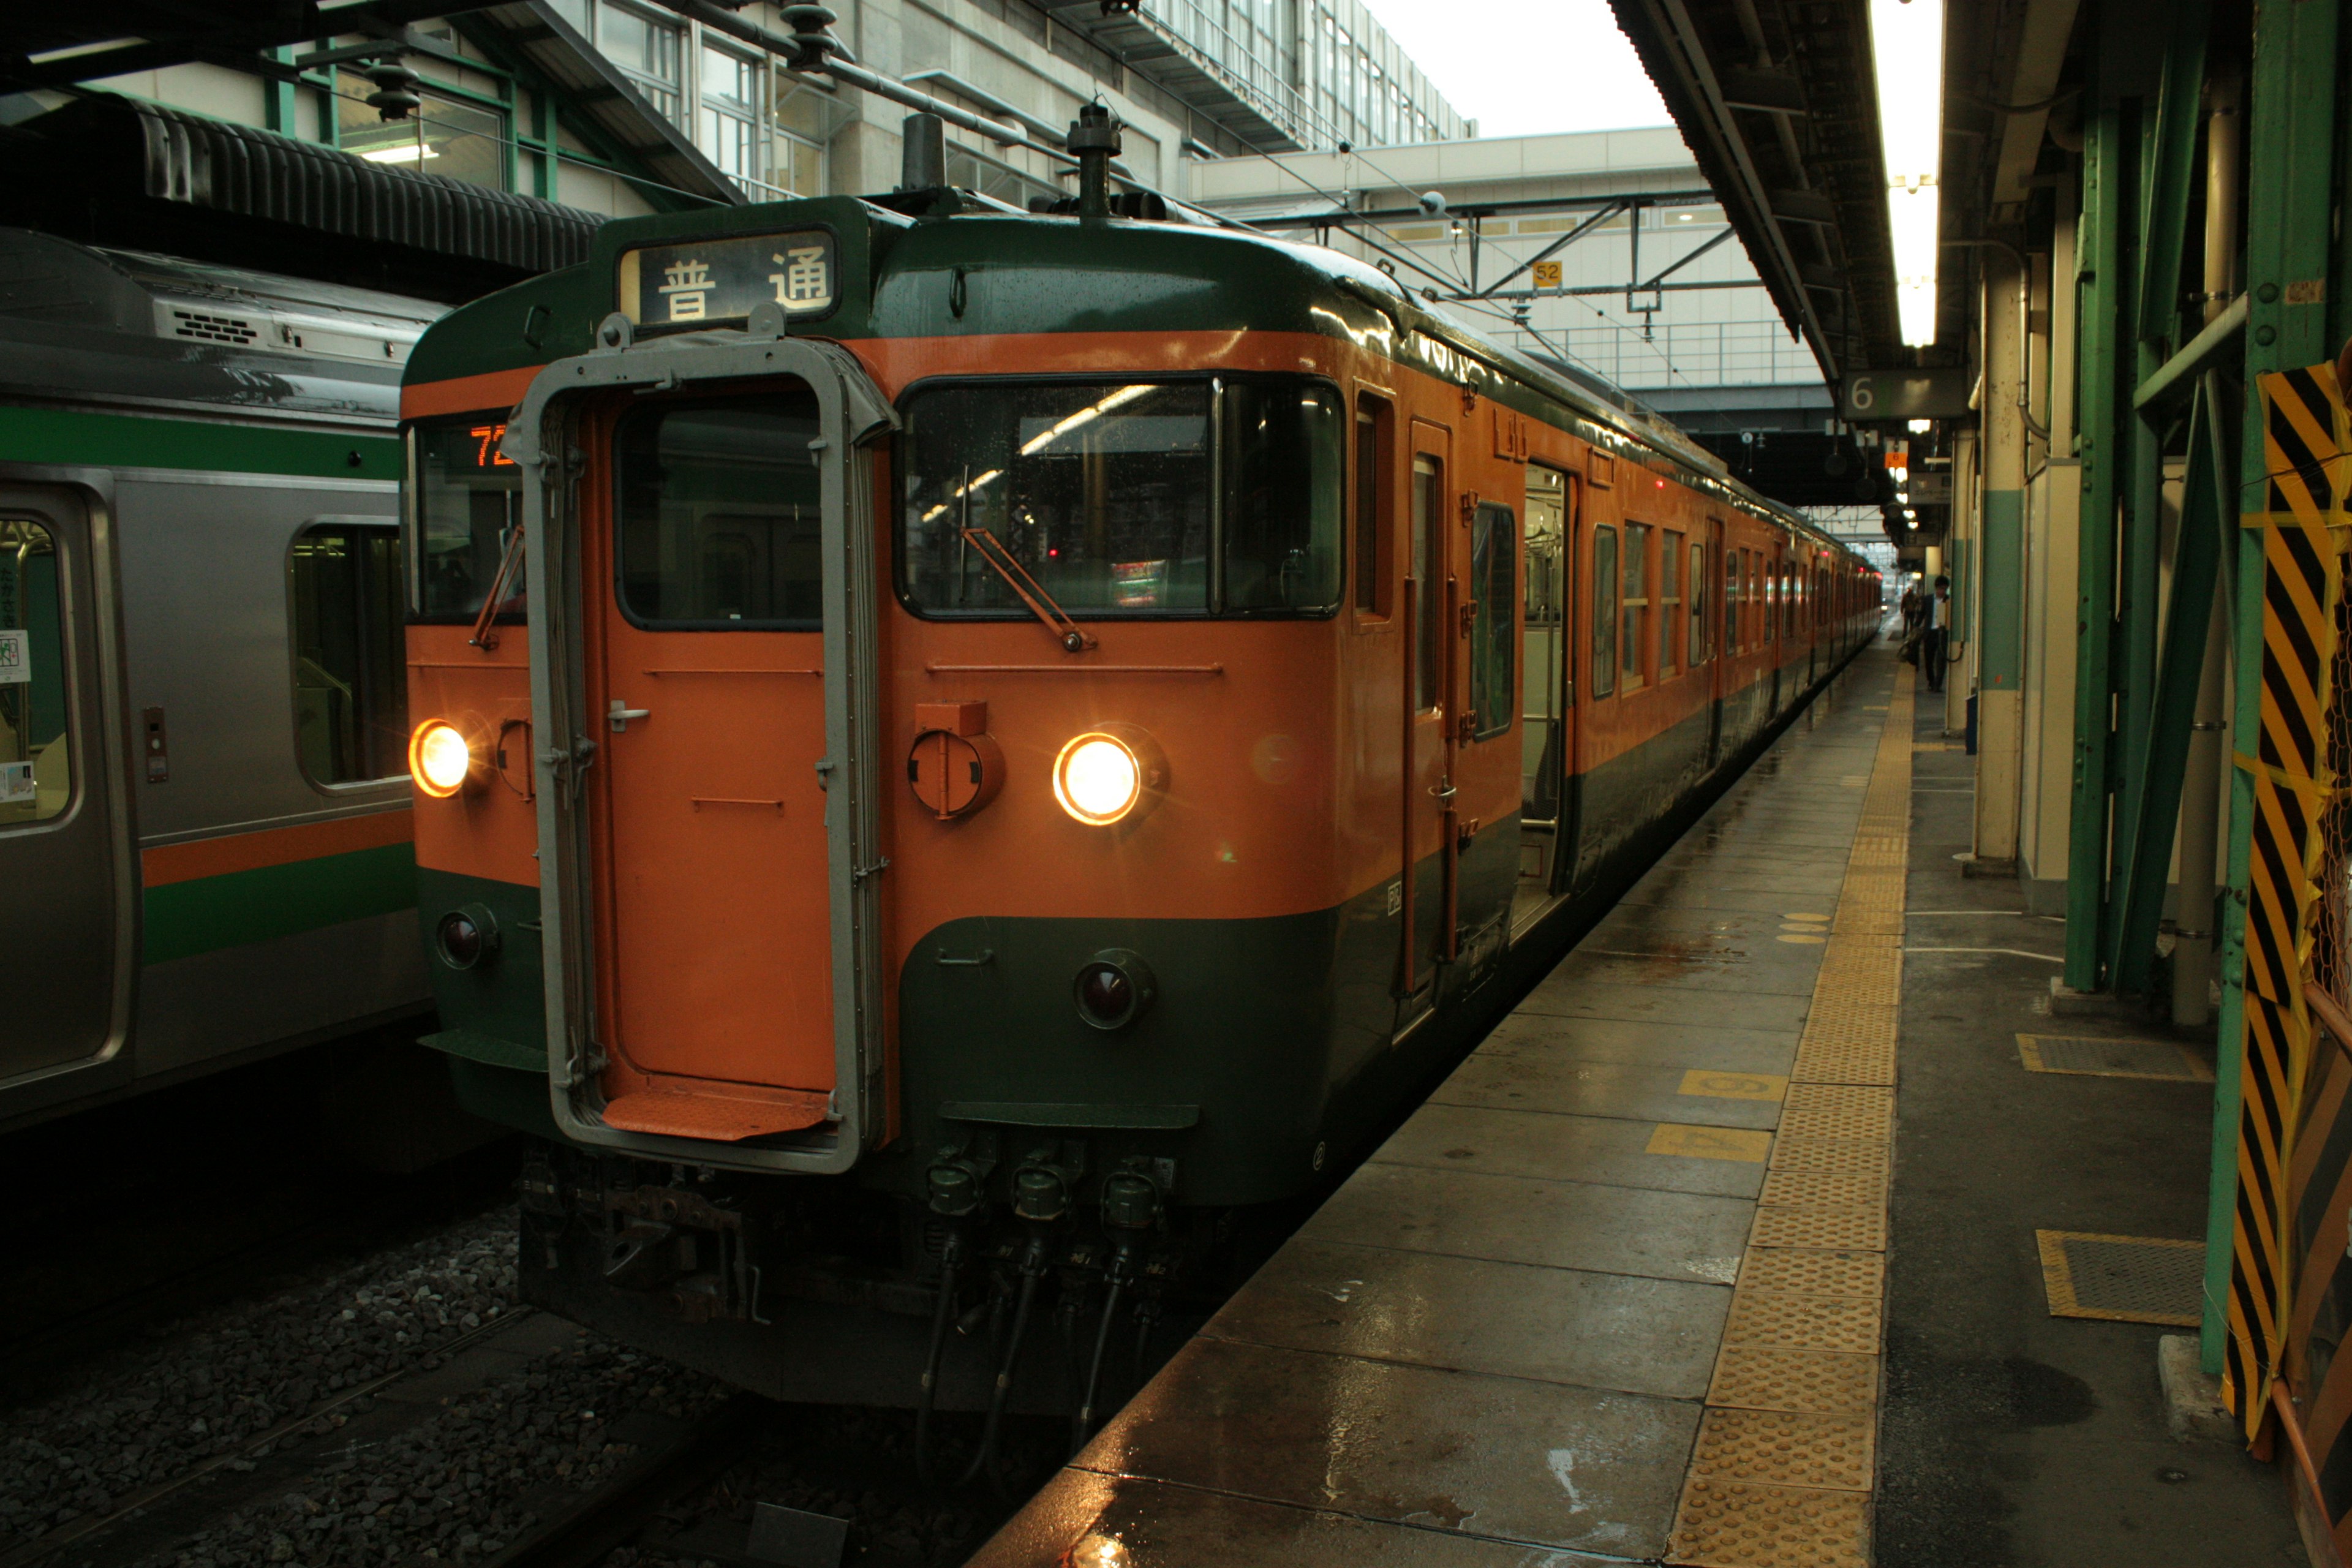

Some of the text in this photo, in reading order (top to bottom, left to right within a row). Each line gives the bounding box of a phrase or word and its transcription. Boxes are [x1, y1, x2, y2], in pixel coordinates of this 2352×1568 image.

[658, 246, 833, 322] 普通
[1537, 264, 1559, 279] 52
[1852, 377, 1874, 410] 6
